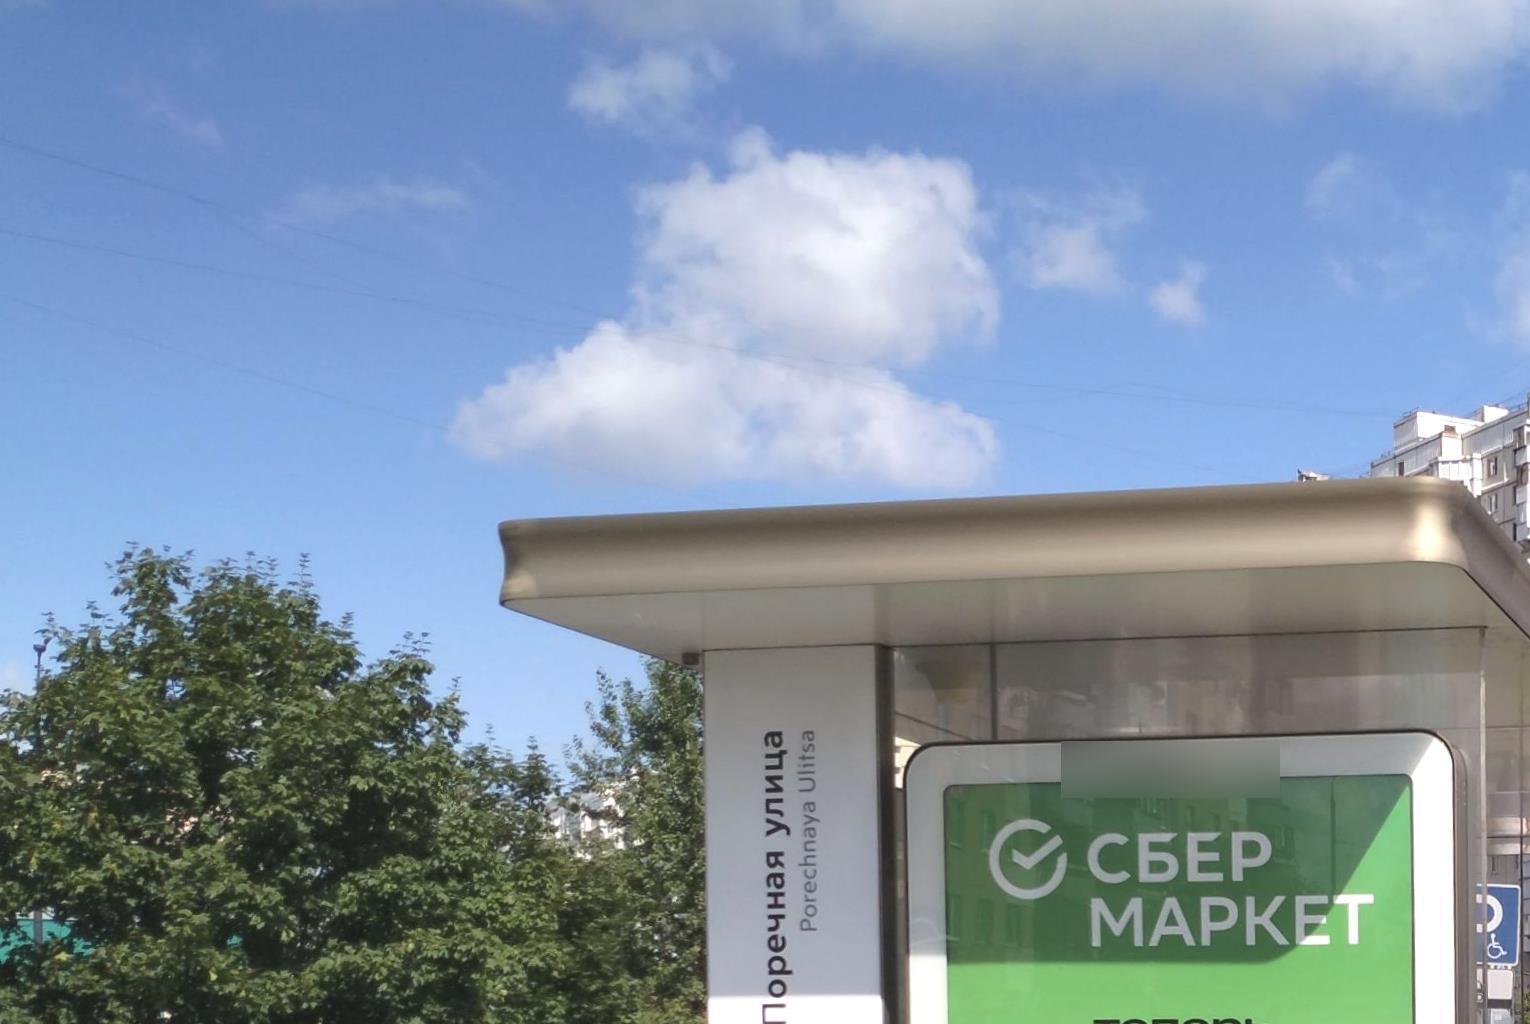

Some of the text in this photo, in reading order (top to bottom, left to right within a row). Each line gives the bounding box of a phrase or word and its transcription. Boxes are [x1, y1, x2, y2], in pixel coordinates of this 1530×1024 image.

[763, 730, 791, 837] улица
[797, 729, 821, 932] Porechnaya Ulitsa
[1087, 831, 1273, 883] СБЕР
[1089, 893, 1375, 948] МАРКЕТ
